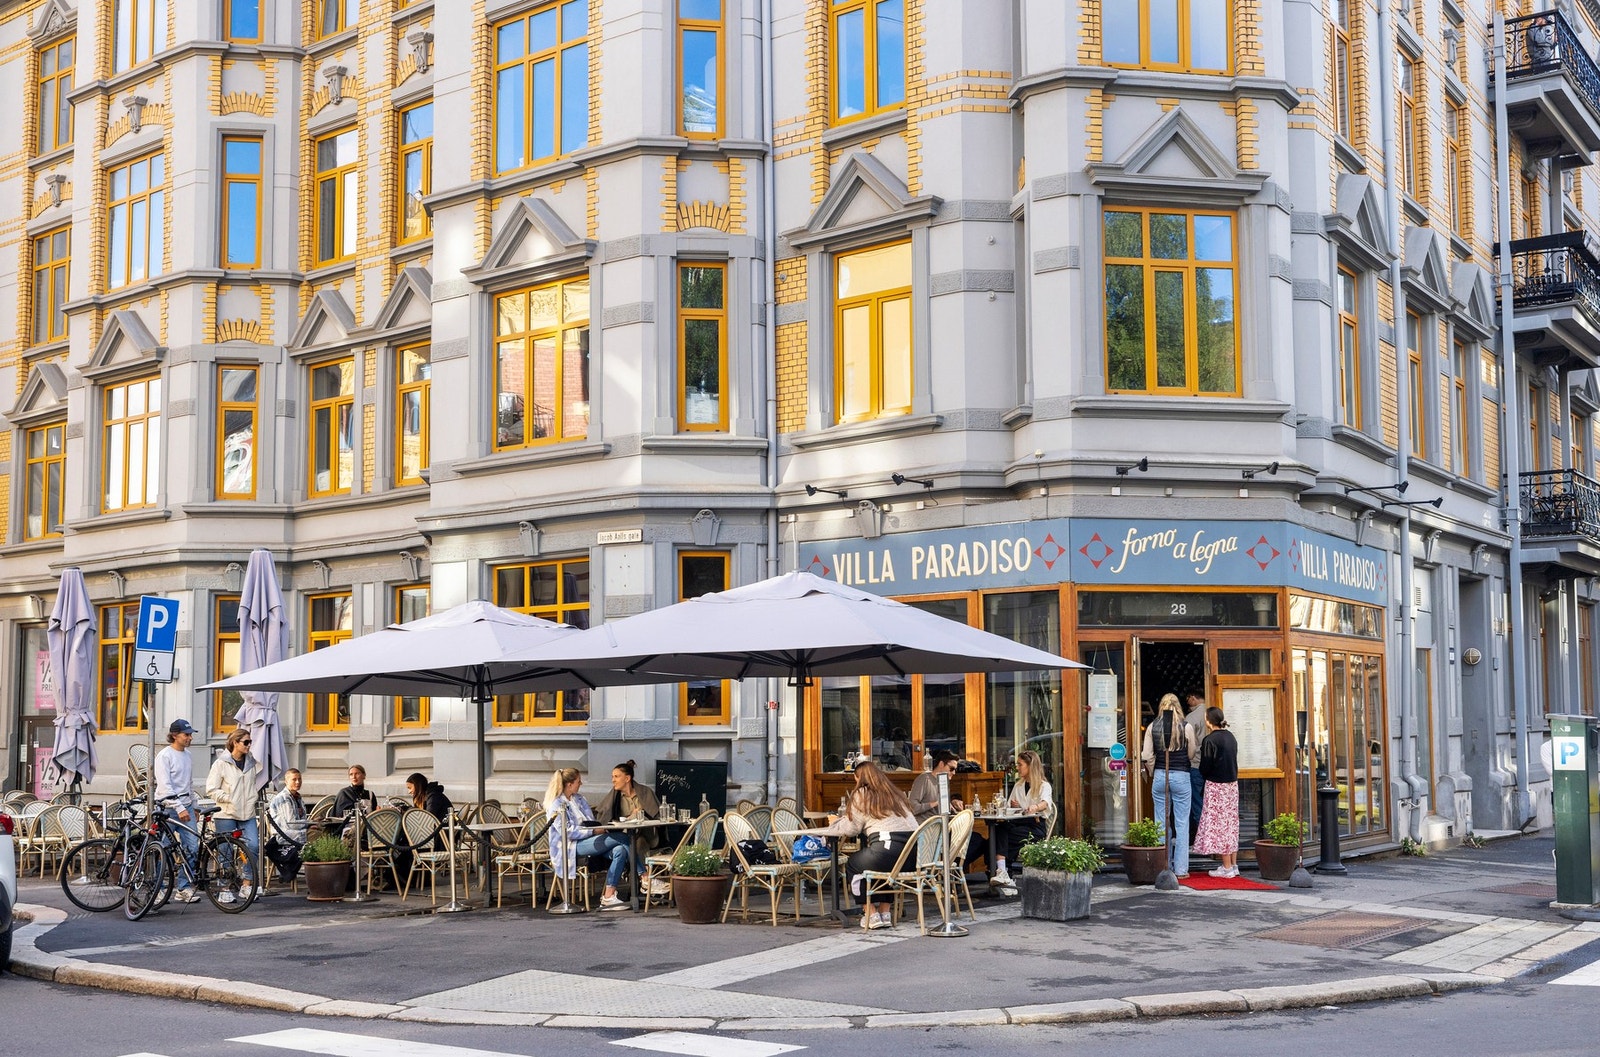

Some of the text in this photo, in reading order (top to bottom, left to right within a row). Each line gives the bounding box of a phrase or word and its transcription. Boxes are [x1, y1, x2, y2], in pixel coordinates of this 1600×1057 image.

[832, 537, 1032, 585] VILLA PARADISO
[1110, 527, 1238, 575] forno a legna
[1300, 541, 1376, 591] VILLA PARADISO
[146, 604, 169, 643] P
[1170, 603, 1187, 615] 28
[40, 757, 54, 781] 1/2
[1560, 742, 1580, 765] P
[41, 783, 53, 791] PRIS
